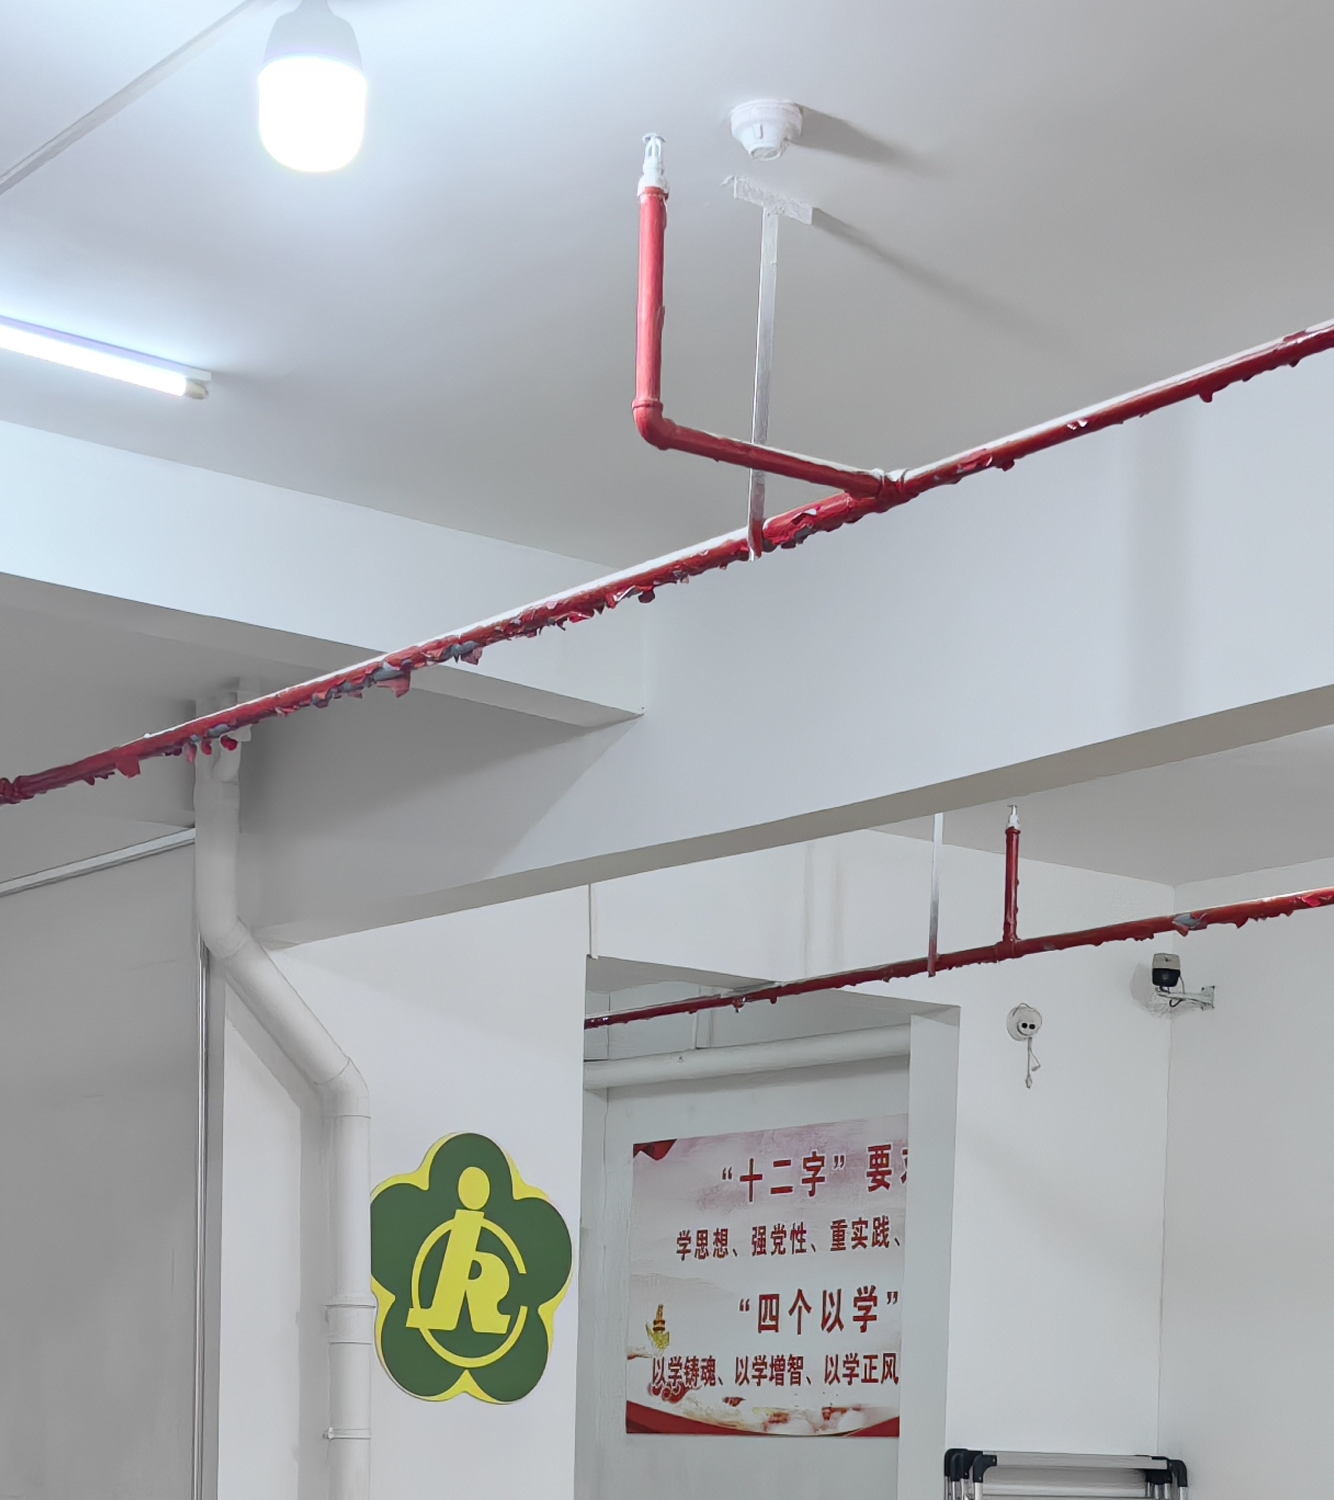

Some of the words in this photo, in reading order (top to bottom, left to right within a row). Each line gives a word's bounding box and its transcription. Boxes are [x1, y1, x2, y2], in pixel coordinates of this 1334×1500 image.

[676, 1215, 901, 1261] 学思想、强党性、重实践、
[739, 1285, 899, 1335] “四个以学”
[652, 1353, 900, 1387] 以学铸魂、以学增智、以学正风
